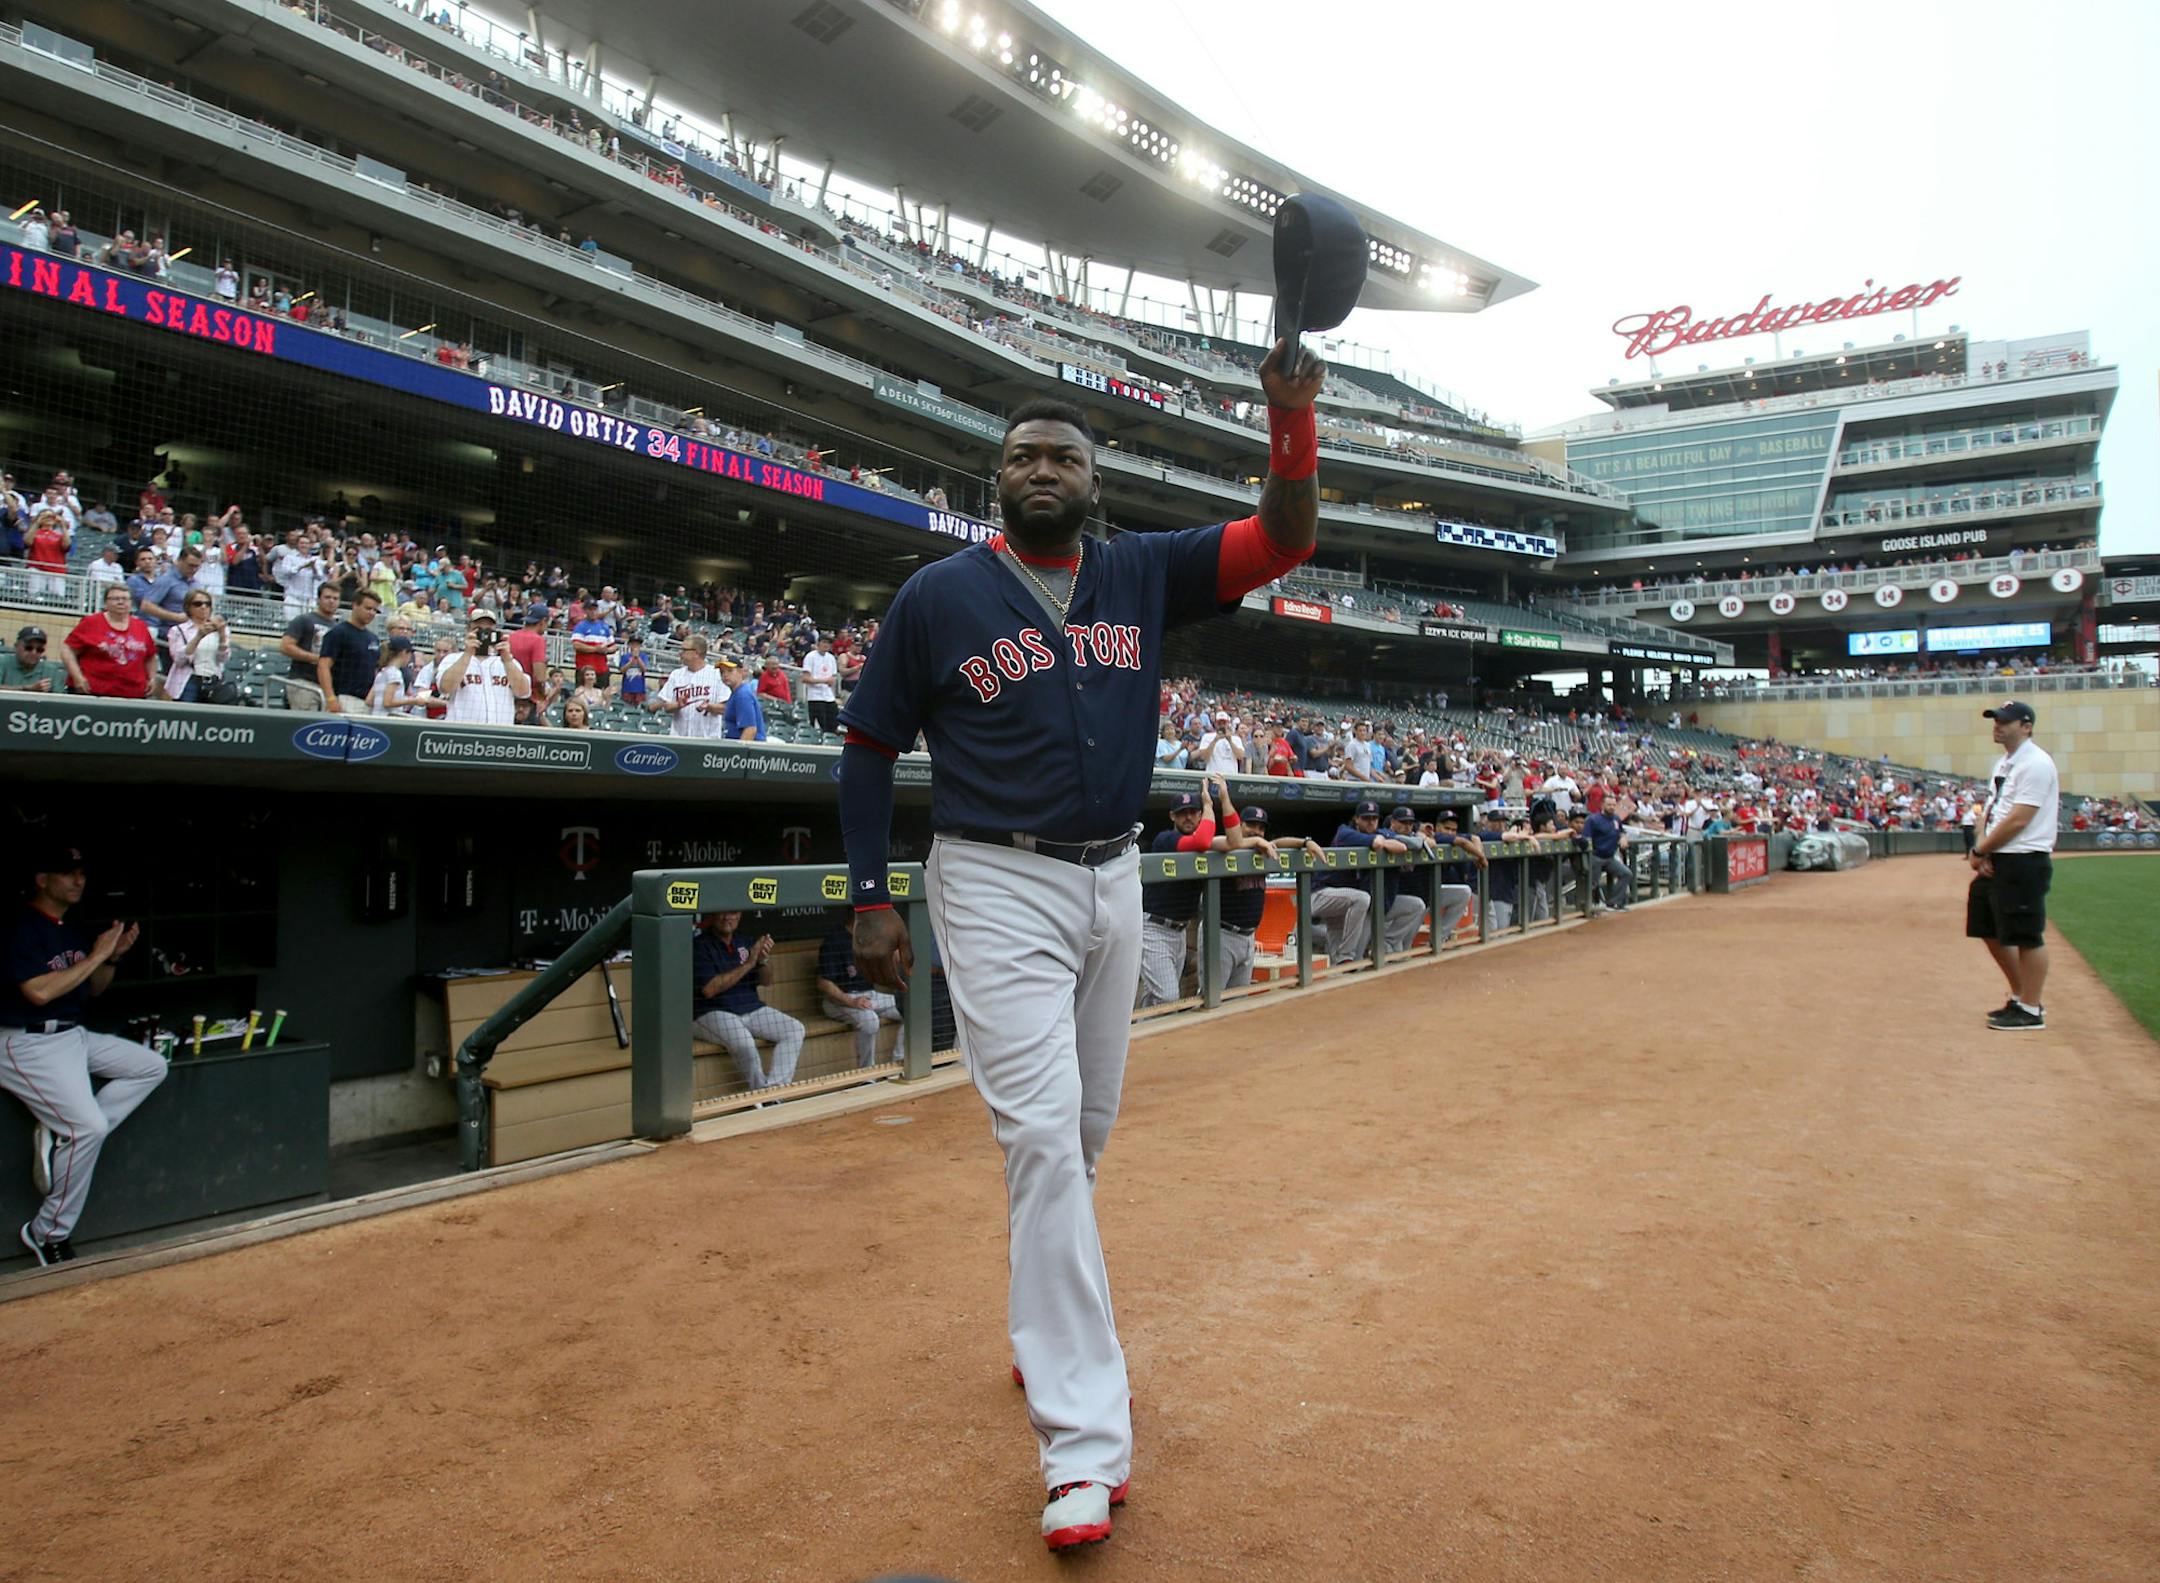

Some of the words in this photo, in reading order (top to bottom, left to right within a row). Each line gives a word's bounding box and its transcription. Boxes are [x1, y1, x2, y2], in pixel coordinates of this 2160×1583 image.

[145, 290, 275, 354] SEASON
[1612, 276, 1962, 360] Budweiser
[888, 388, 919, 407] DELTA
[953, 410, 988, 433] LEGENDS
[488, 386, 564, 431] DAVID
[570, 410, 639, 451] ORTIZ
[647, 428, 681, 463] 34
[686, 442, 754, 482] FINAL
[761, 464, 824, 501] SEASON
[1594, 457, 1620, 475] IT'S
[1624, 457, 1633, 472] A
[1636, 449, 1706, 471] BEAUTIFUL
[1709, 446, 1733, 461] DAY
[1759, 435, 1827, 455] BASEBALL
[1688, 502, 1734, 519] TWINS
[928, 511, 968, 540] DAVID
[1882, 536, 1919, 552] GOOSE
[1920, 532, 1961, 548] ISLAND
[1963, 529, 1987, 543] PUB
[2063, 574, 2071, 586] 3
[1881, 590, 1895, 602] 14
[1939, 585, 1948, 597] 6
[1826, 594, 1842, 606] 34
[1676, 605, 1689, 616] 42
[1725, 601, 1737, 612] 10
[1448, 629, 1460, 638] ICE
[1460, 630, 1486, 641] CREAM
[958, 621, 1142, 704] BOSTON
[7, 710, 255, 744] StayComfyMN.com
[305, 728, 380, 751] Carrier
[423, 737, 585, 763] twinsbaseball.com
[623, 750, 672, 766] Carrier
[702, 753, 817, 775] StayComfyMN.com
[825, 879, 847, 888] BEST
[889, 876, 909, 885] BEST
[671, 885, 699, 897] BEST
[752, 882, 776, 892] BEST
[825, 887, 844, 896] BUY
[889, 883, 907, 892] BUY
[671, 895, 695, 905] BUY
[752, 890, 774, 900] BUY
